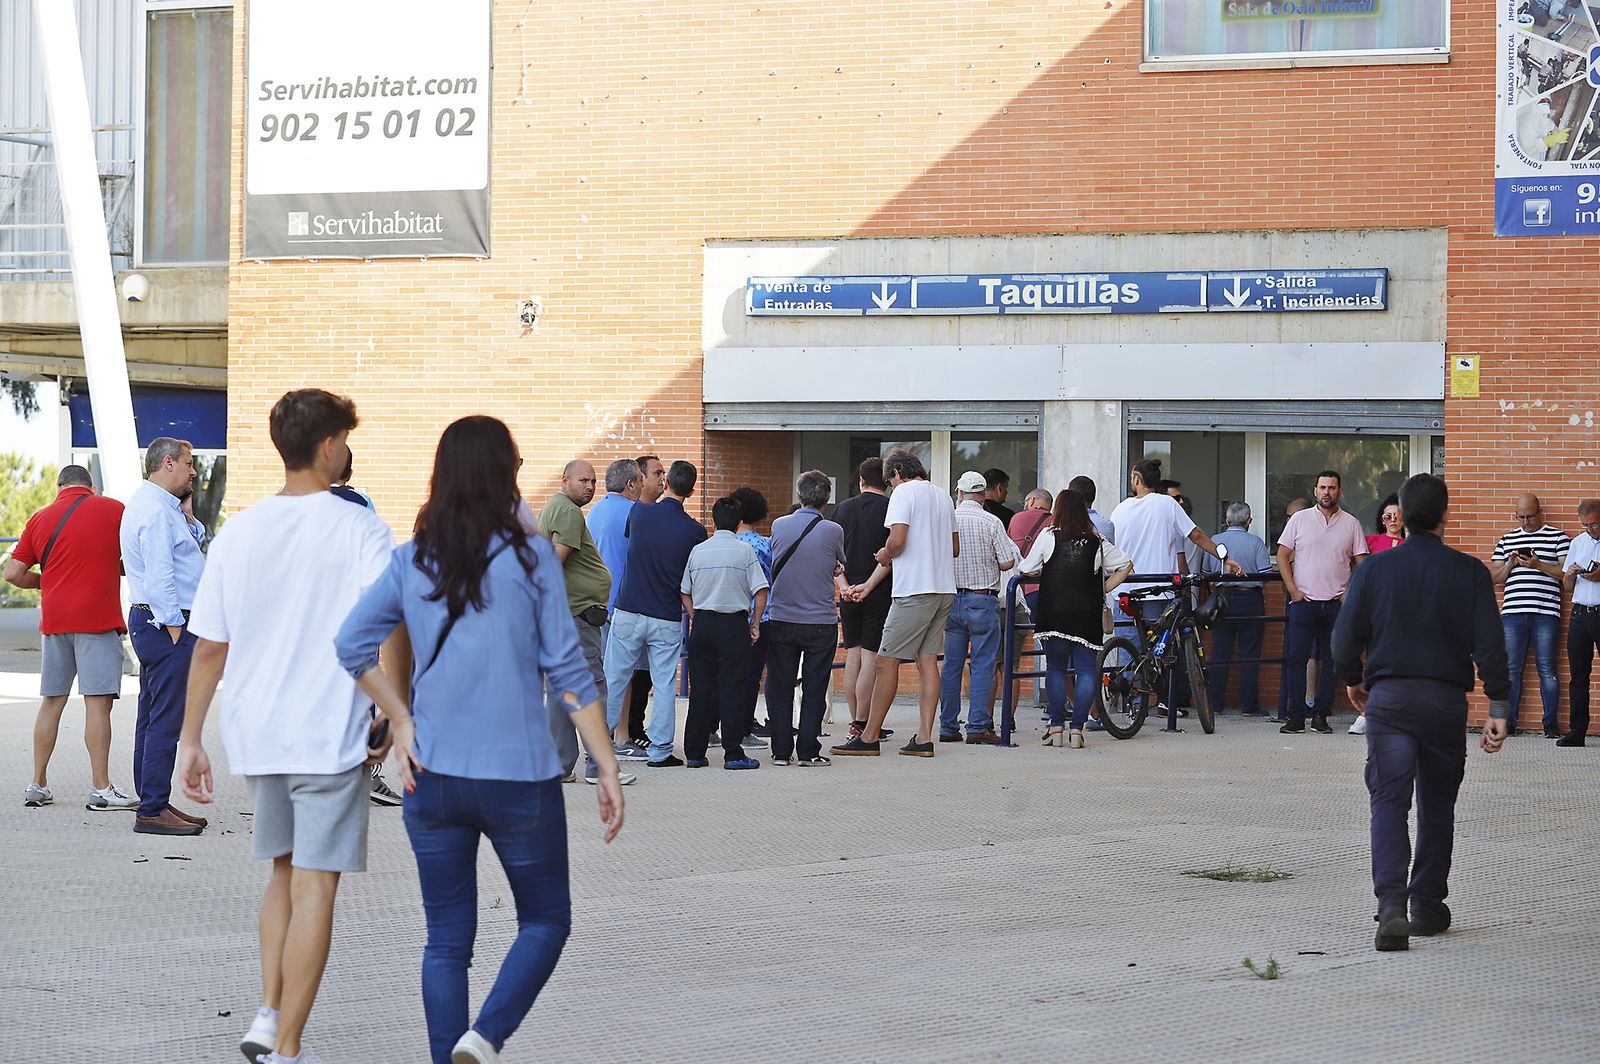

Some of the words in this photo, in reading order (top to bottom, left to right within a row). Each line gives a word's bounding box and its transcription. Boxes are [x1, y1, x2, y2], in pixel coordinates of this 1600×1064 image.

[1228, 2, 1257, 17] Sala
[1263, 1, 1279, 15] de
[1284, 0, 1316, 15] Ocio
[258, 75, 478, 101] Servihabitat.com
[1507, 72, 1515, 106] TRABAJO
[259, 112, 320, 143] 902
[333, 111, 372, 140] 15
[382, 109, 421, 139] 01
[435, 107, 476, 137] 02
[1577, 183, 1600, 204] 9
[313, 210, 443, 236] Servihabitat
[764, 282, 808, 293] Venta
[813, 282, 832, 293] de
[1264, 275, 1317, 289] Salida
[978, 276, 1140, 310] Taquillas
[1263, 295, 1277, 308] T.
[1283, 293, 1380, 308] Incidencias
[764, 298, 833, 311] Entradas
